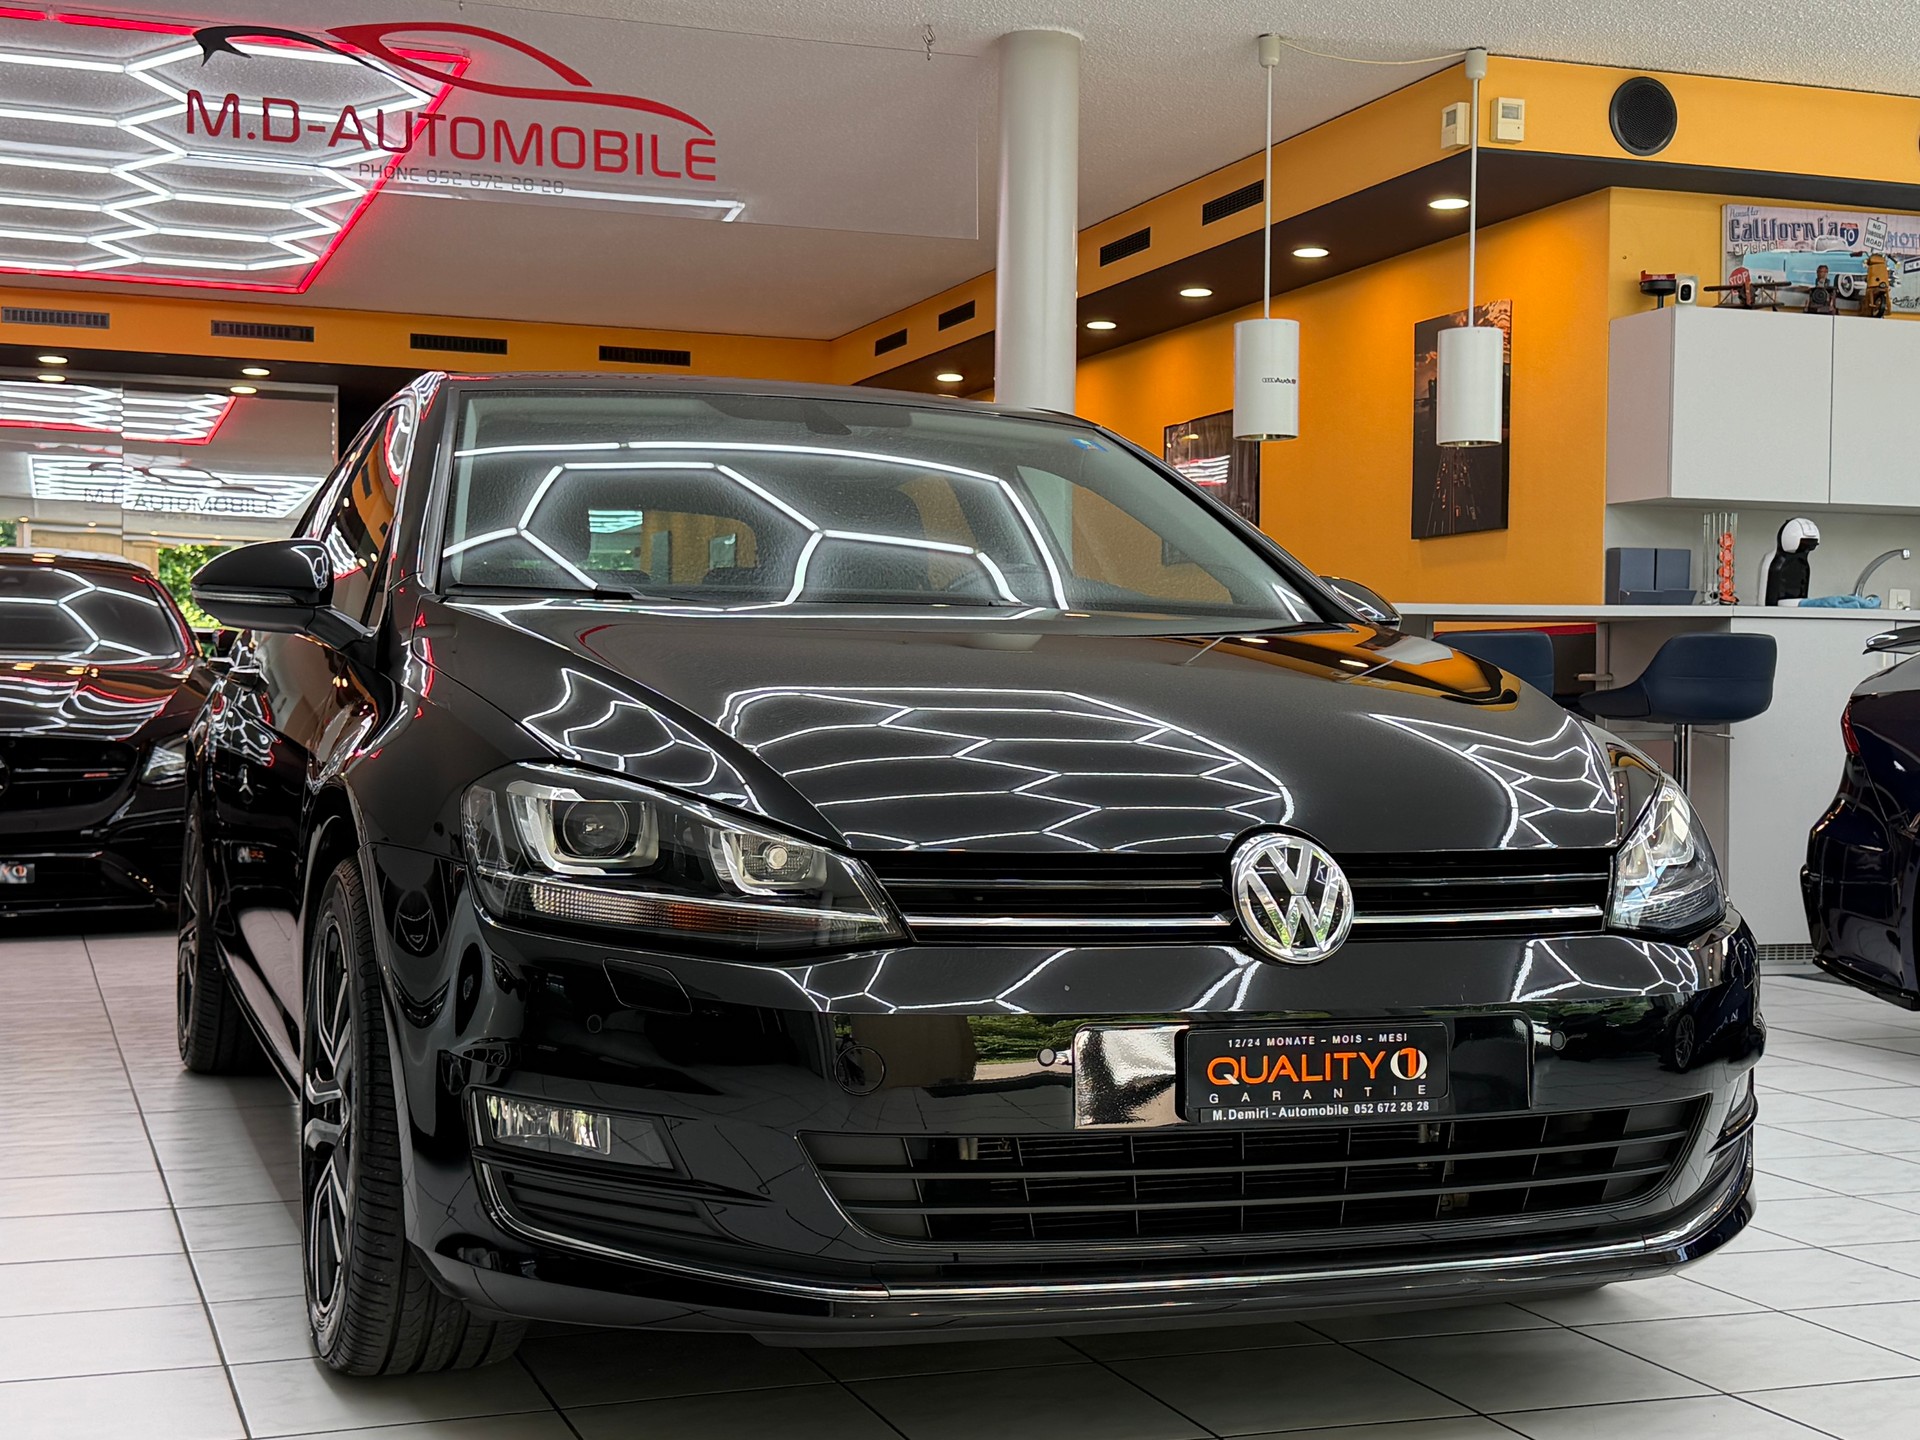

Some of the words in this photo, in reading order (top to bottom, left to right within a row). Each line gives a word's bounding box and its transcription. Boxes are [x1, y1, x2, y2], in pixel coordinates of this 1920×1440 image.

[187, 90, 716, 181] M.D-AUTOMOBILE
[358, 163, 419, 182] PHONE
[470, 173, 503, 189] 672
[1729, 216, 1838, 243] California
[1844, 229, 1856, 242] 10
[1872, 223, 1882, 231] NO
[1865, 237, 1883, 248] ROAD
[1729, 271, 1749, 285] STOP
[1228, 1038, 1261, 1048] 12/24
[1266, 1036, 1316, 1046] MONATE
[1332, 1035, 1362, 1044] MOIS
[1379, 1033, 1407, 1042] MESI
[1207, 1050, 1386, 1086] QUALITY
[1209, 1084, 1426, 1104] GARANTIE
[1212, 1107, 1269, 1121] M.Demiri
[1279, 1103, 1349, 1118] Automobile
[1354, 1103, 1374, 1114] 052
[1377, 1102, 1397, 1113] 672
[1400, 1101, 1413, 1112] 28
[1417, 1100, 1430, 1111] 28
